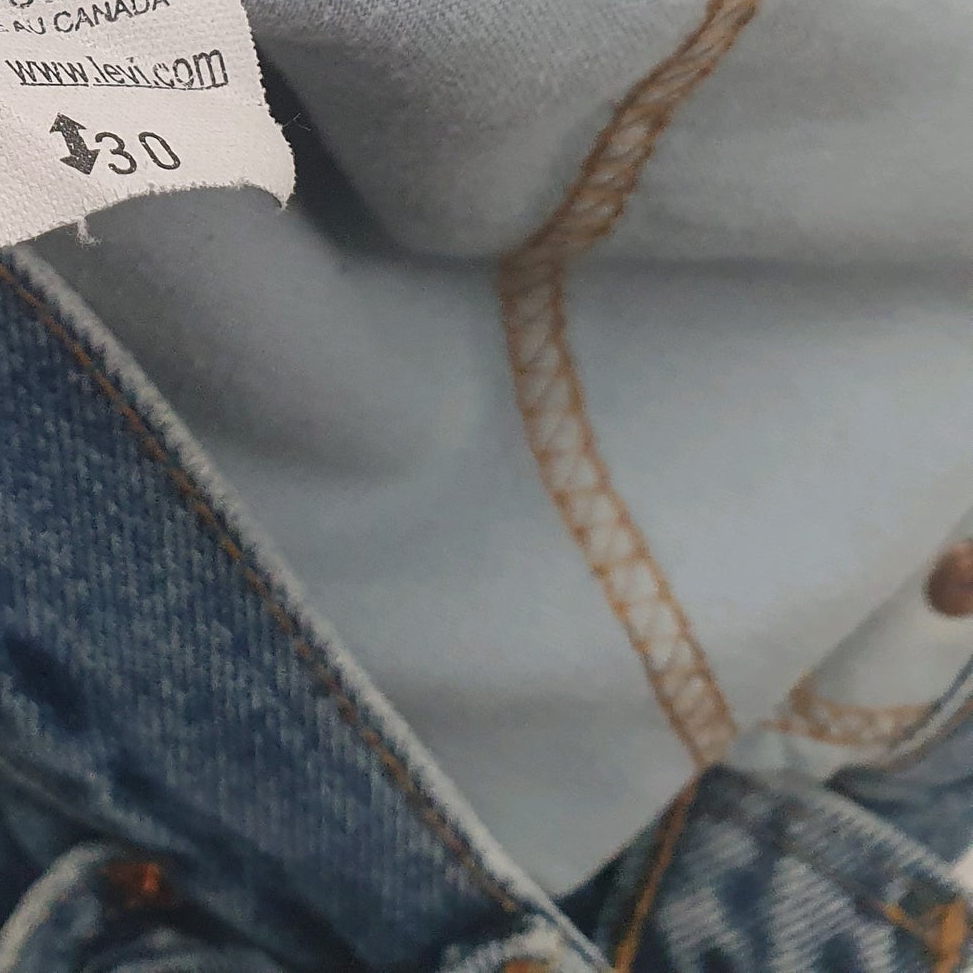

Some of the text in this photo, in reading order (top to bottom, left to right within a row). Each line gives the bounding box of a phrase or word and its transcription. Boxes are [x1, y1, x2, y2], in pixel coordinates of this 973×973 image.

[12, 16, 47, 35] AU
[5, 49, 229, 91] www.levi.com
[94, 131, 182, 175] 30
